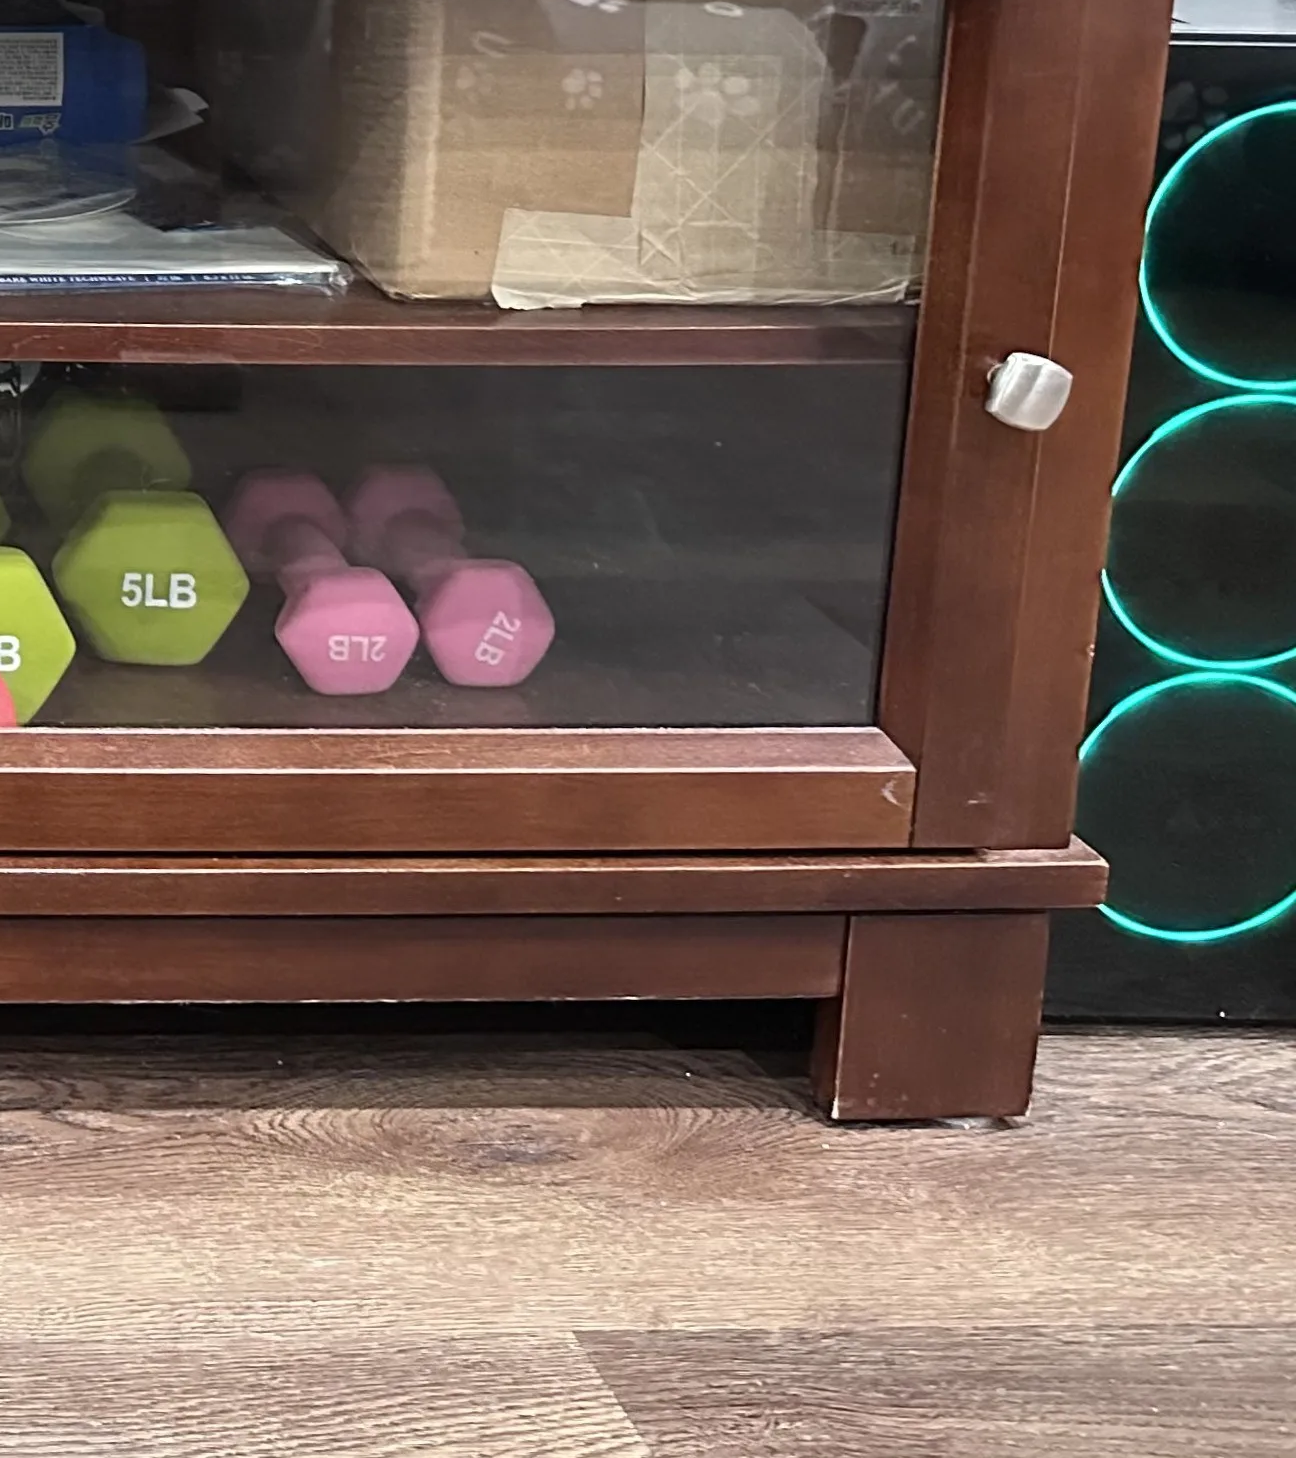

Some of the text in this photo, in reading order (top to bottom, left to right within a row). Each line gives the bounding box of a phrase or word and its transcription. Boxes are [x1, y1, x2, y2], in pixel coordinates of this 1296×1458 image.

[121, 572, 197, 609] 5LB
[327, 635, 387, 662] 2LB
[474, 610, 523, 666] 2LB
